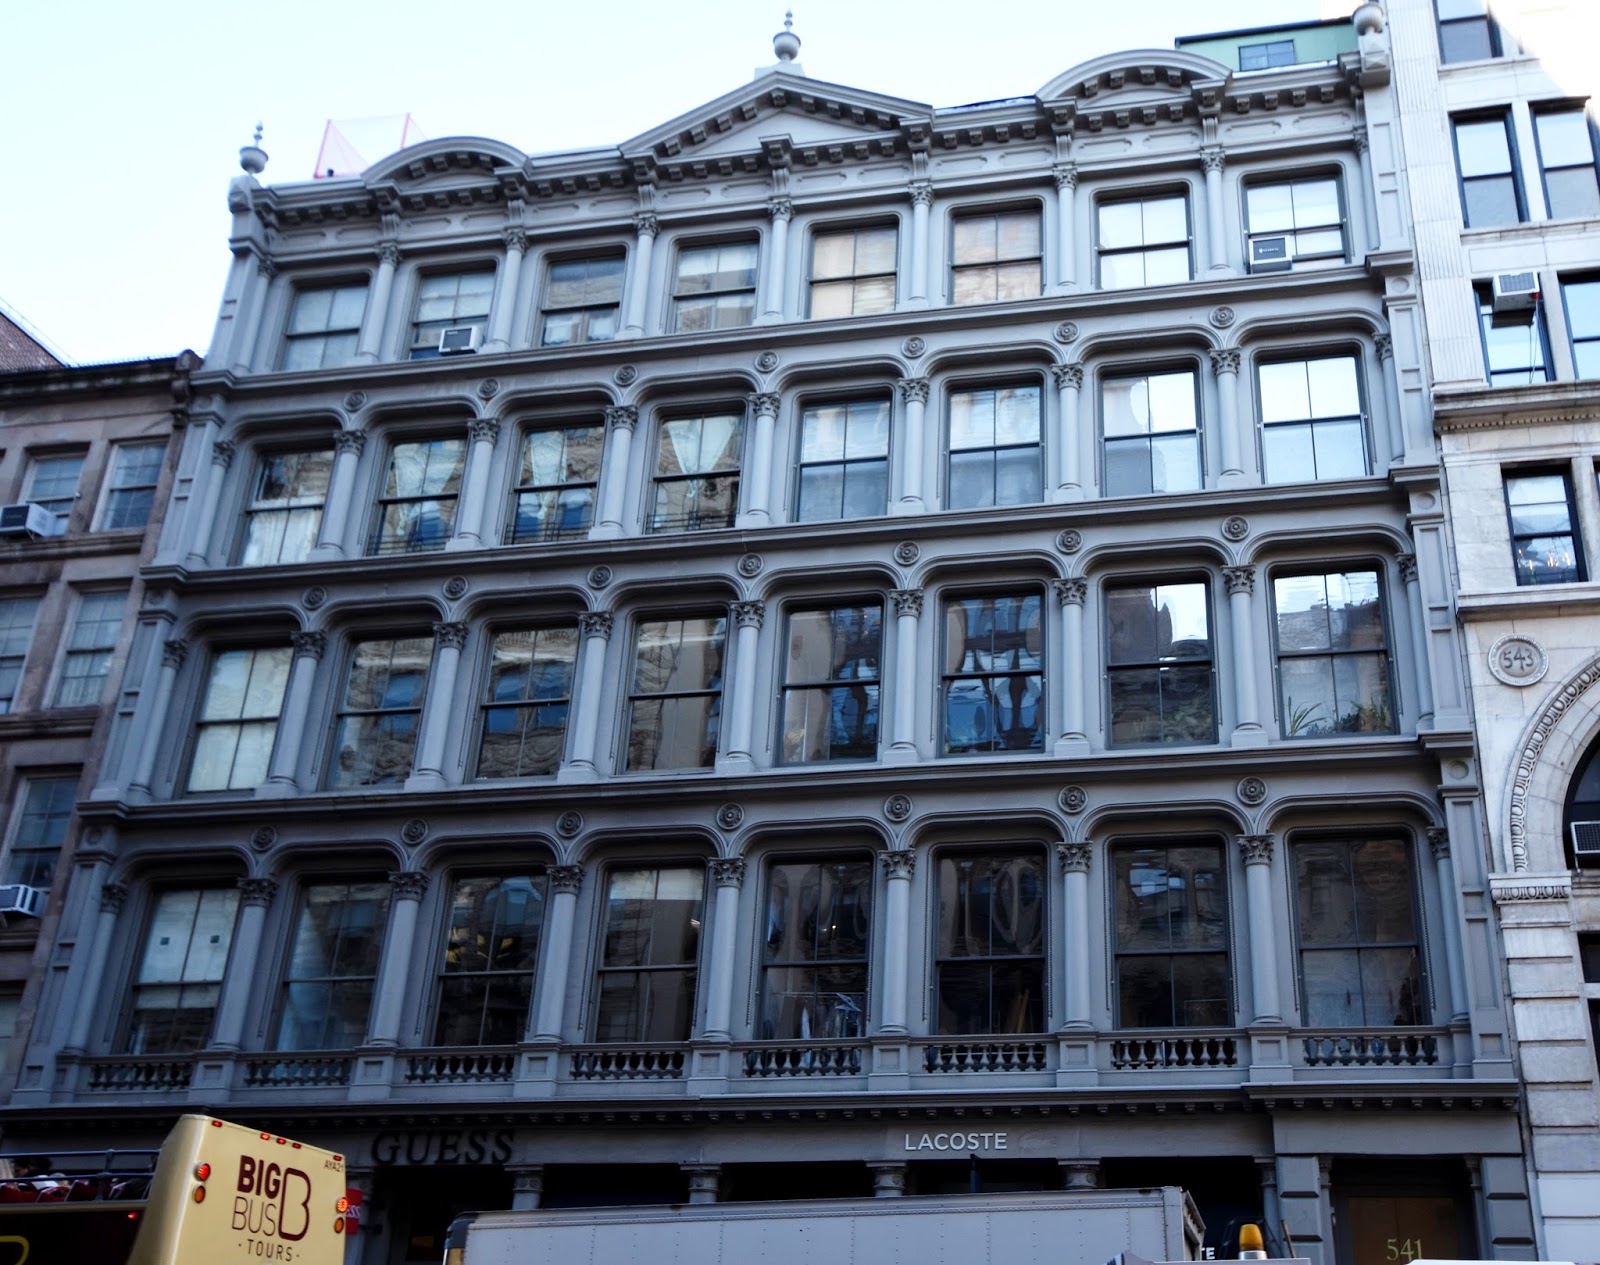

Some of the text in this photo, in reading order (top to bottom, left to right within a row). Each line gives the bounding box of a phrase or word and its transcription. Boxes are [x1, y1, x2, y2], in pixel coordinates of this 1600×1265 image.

[1503, 646, 1534, 672] 543
[371, 1129, 515, 1164] GUESS
[904, 1132, 1008, 1151] LACOSTE
[237, 1154, 281, 1199] BIG
[231, 1196, 277, 1237] BUS
[278, 1167, 311, 1241] B
[247, 1238, 293, 1262] TOURS
[1386, 1238, 1422, 1262] 541
